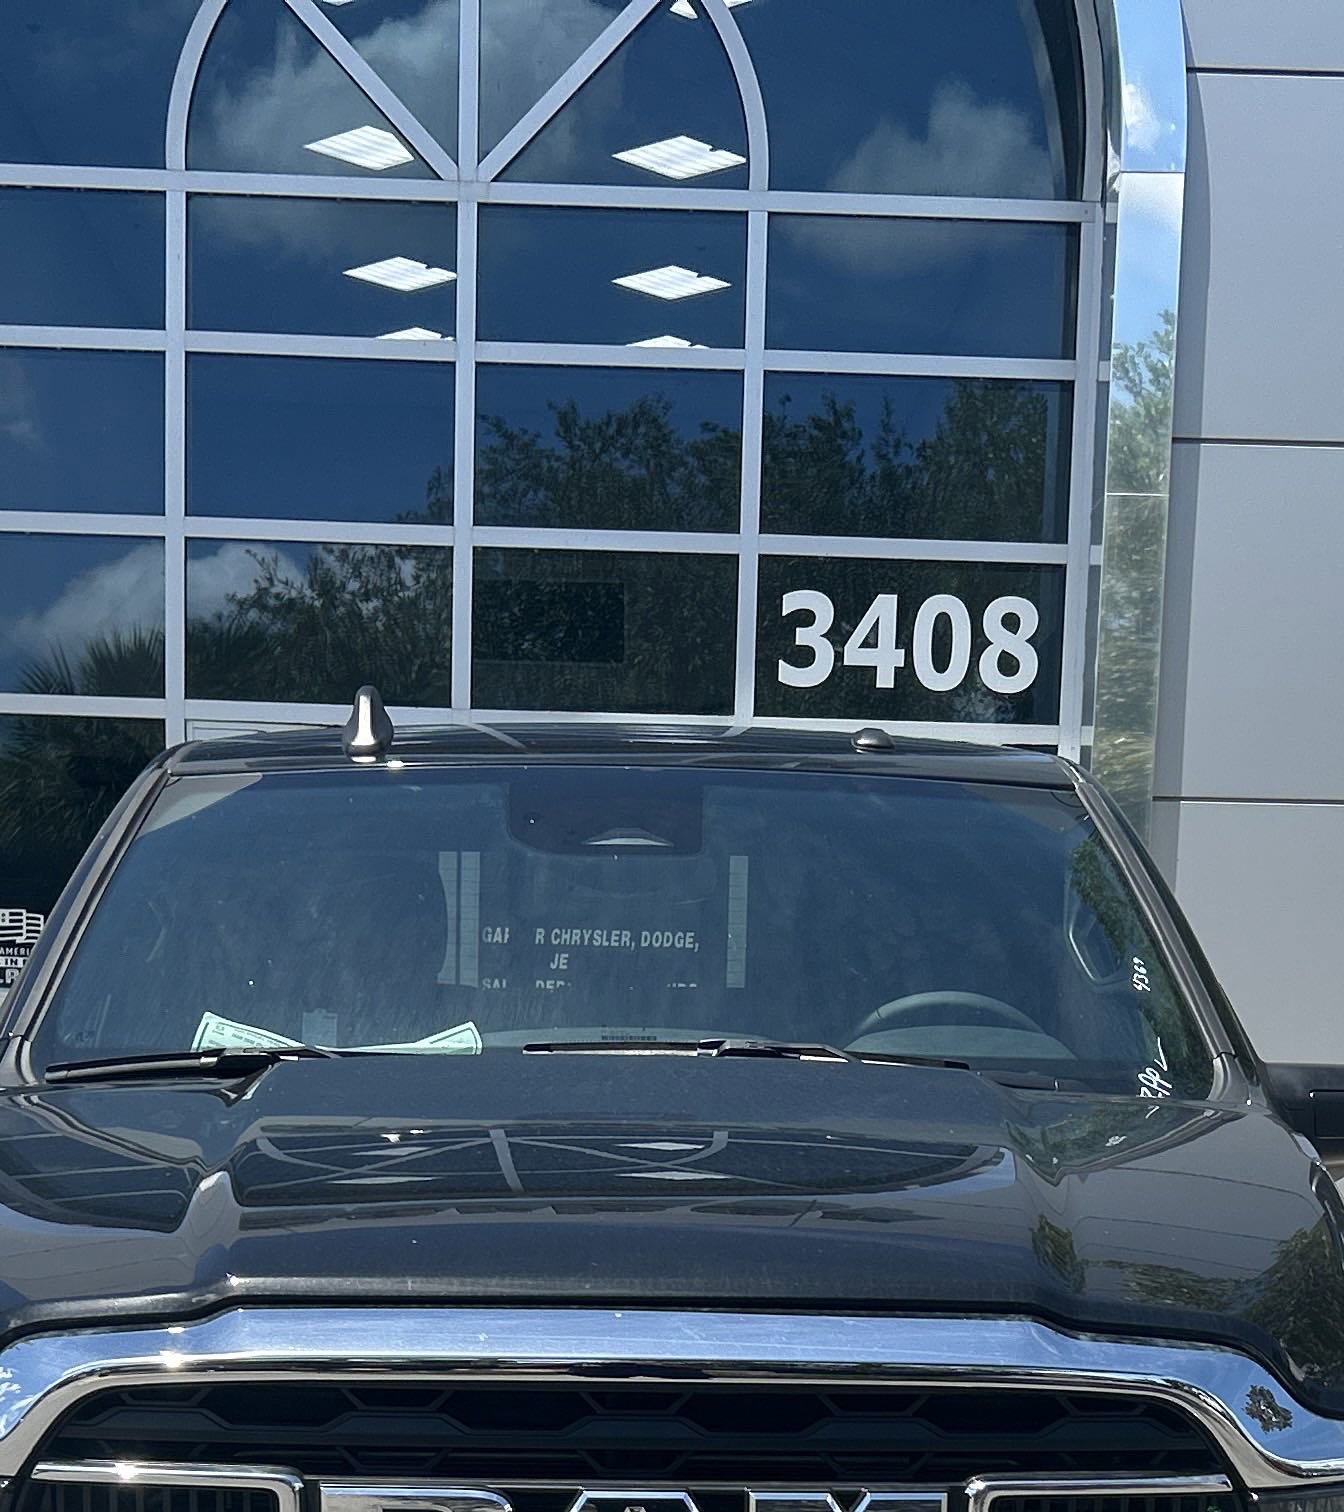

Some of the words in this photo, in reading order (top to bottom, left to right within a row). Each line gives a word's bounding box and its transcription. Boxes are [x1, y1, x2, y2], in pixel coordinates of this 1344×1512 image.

[777, 589, 1039, 694] 3408
[551, 927, 635, 951] CHRYSLER,
[640, 931, 699, 952] DODGE,
[4, 958, 18, 966] IN
[549, 952, 569, 970] JE
